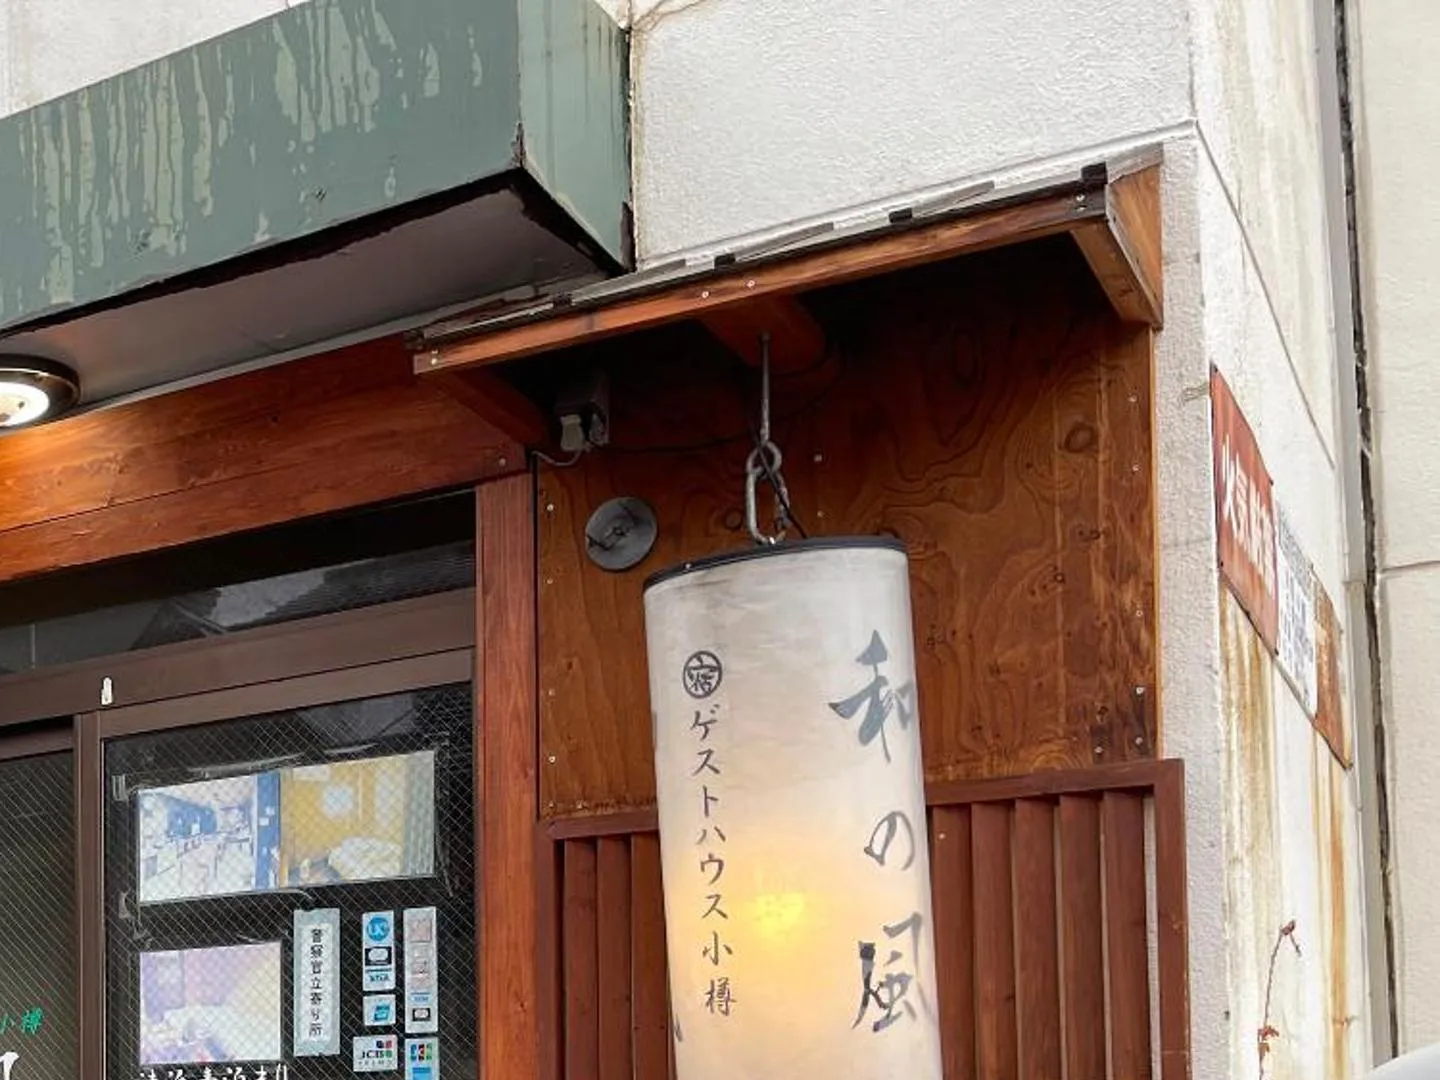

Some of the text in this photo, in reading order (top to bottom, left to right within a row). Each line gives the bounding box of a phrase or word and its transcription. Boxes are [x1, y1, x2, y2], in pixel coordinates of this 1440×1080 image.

[690, 704, 736, 1017] ゲストハウス小樽
[828, 629, 932, 1033] 和の風
